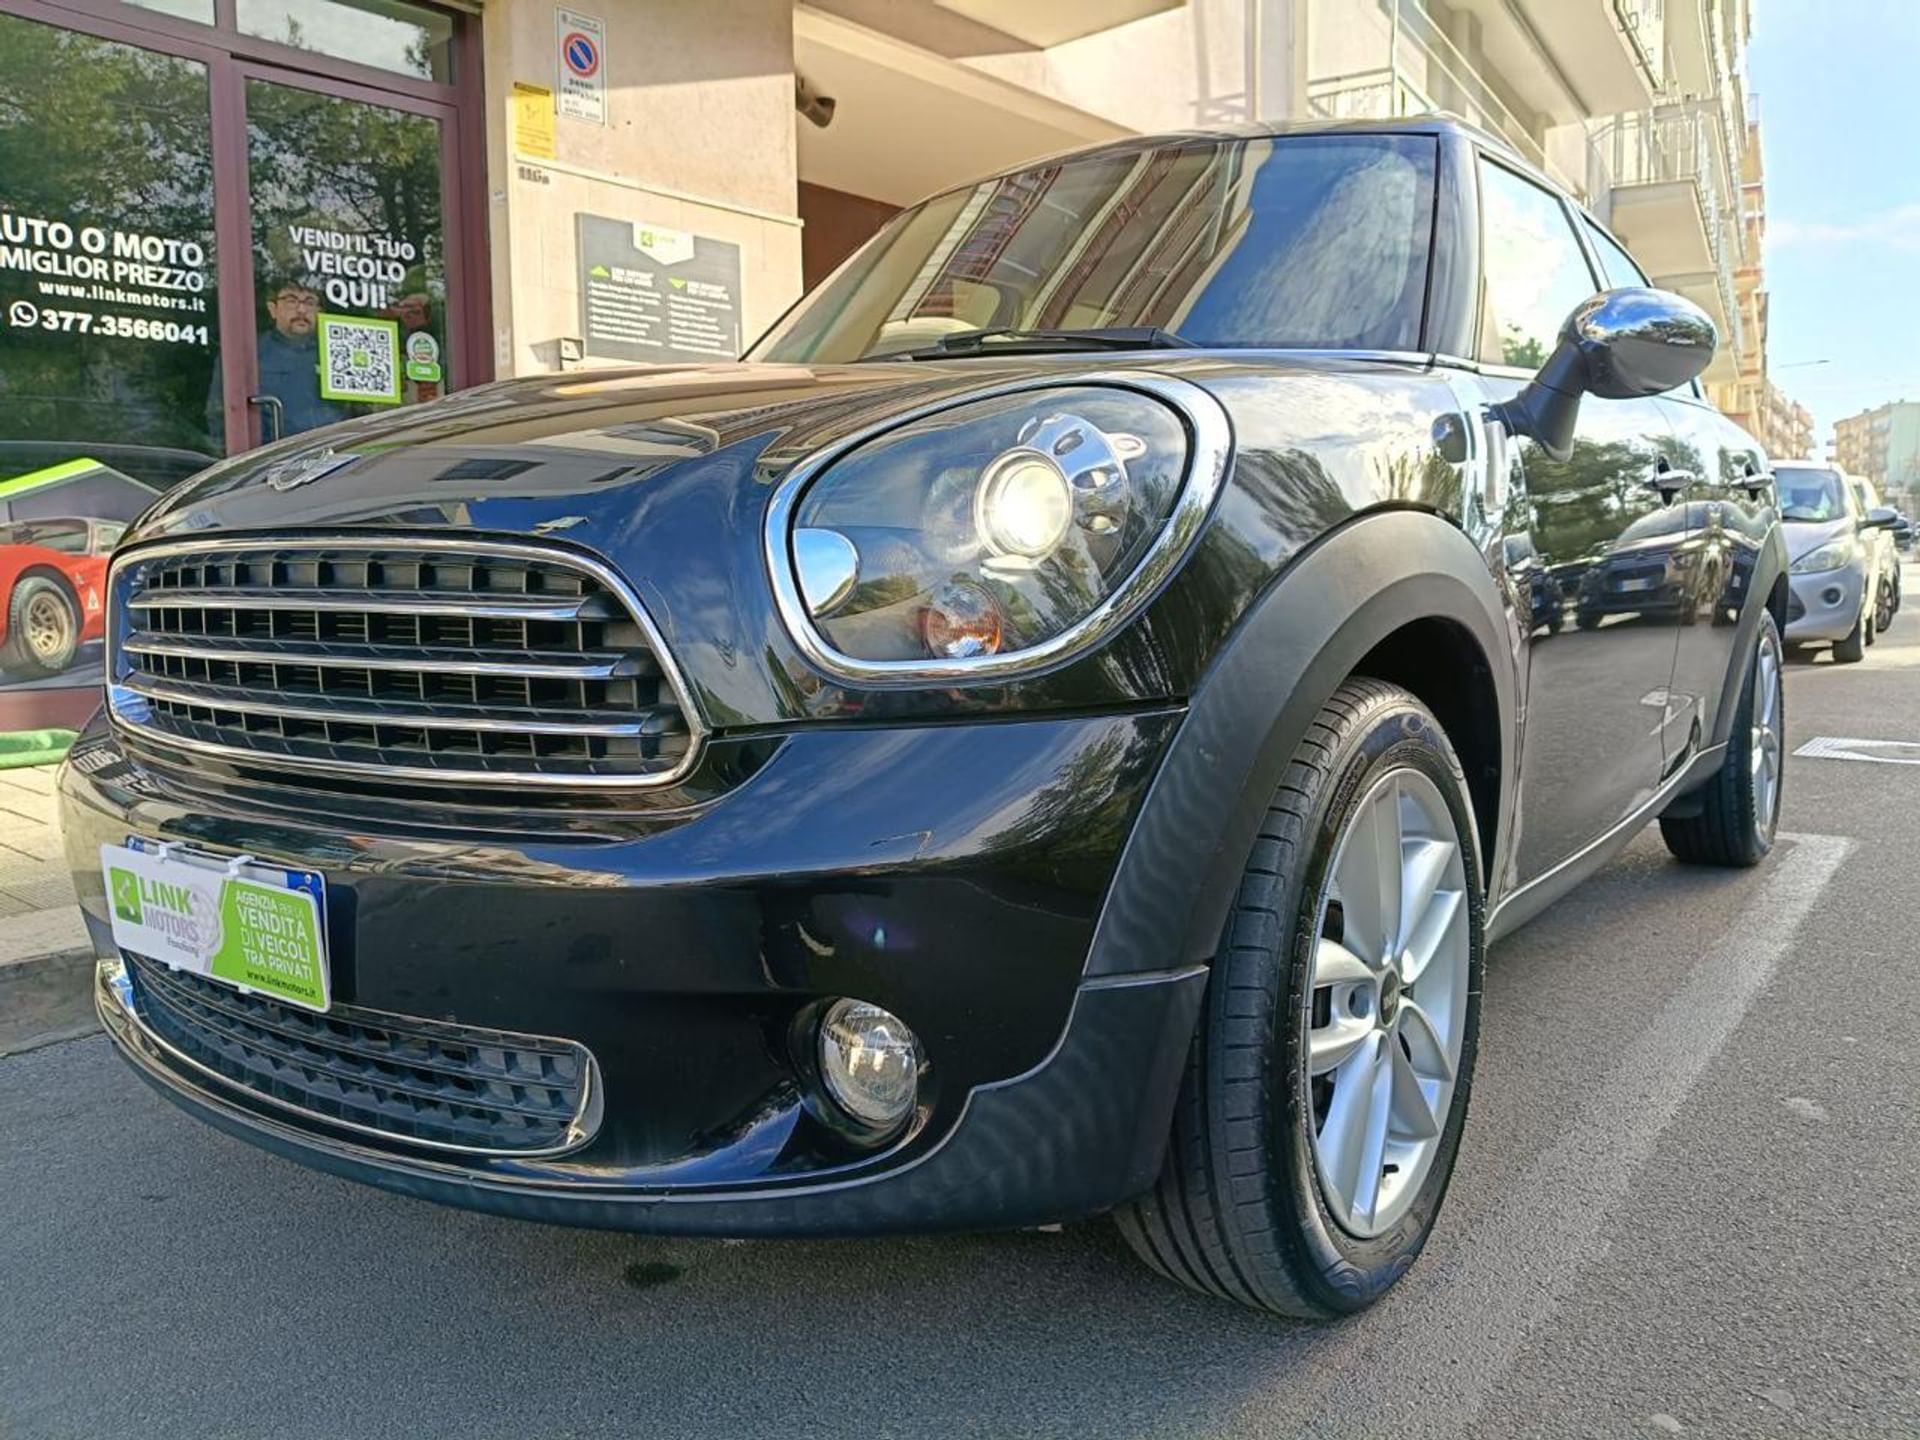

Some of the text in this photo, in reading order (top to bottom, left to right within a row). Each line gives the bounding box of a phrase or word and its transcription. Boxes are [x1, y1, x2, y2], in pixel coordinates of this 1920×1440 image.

[0, 213, 204, 268] UTO O MOTO
[288, 225, 416, 261] VENDI IL TUO
[0, 245, 204, 293] MIGLIOR PREZZO
[303, 249, 406, 284] VEICOLO
[39, 281, 206, 313] www.linkmotors.it
[326, 278, 387, 310] QUI!
[41, 308, 208, 346] 377.3566041
[138, 876, 193, 916] LINK
[235, 890, 278, 913] AGENZIA
[143, 906, 200, 942] MOTORS
[237, 905, 309, 943] VENDITA
[240, 926, 311, 964] DI VEICOLI
[242, 947, 313, 982] TRA PRIVATI
